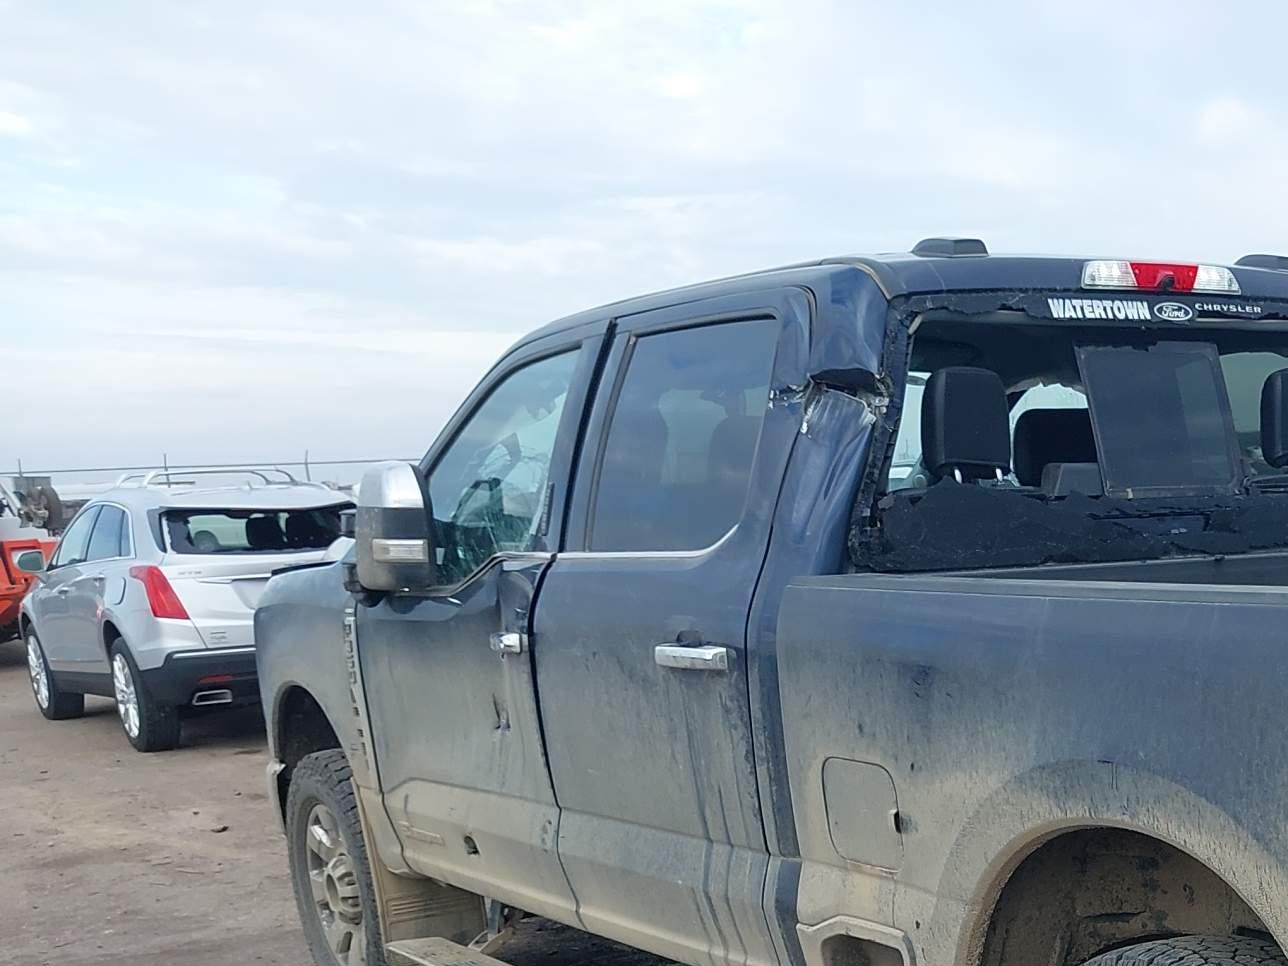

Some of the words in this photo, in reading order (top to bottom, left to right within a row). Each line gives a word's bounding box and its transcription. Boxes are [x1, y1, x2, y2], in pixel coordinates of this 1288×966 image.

[1047, 298, 1151, 320] WATERTOWN
[1160, 303, 1187, 319] Ford
[1195, 303, 1262, 314] CHRYSLER
